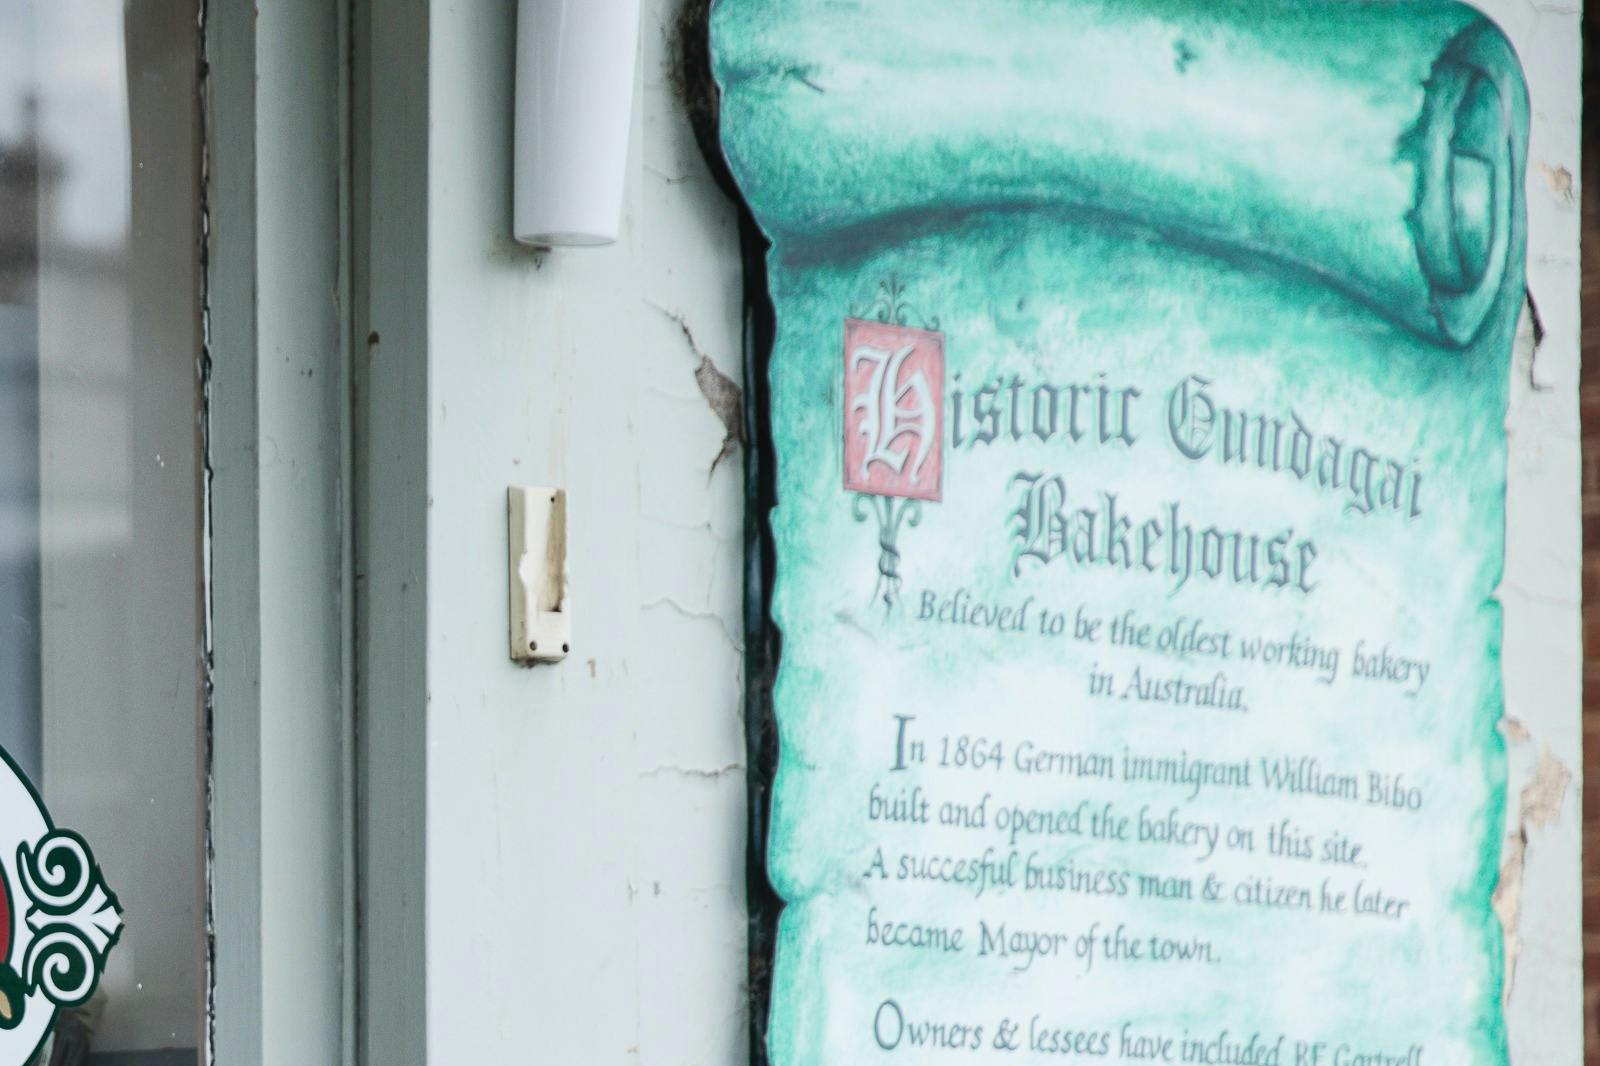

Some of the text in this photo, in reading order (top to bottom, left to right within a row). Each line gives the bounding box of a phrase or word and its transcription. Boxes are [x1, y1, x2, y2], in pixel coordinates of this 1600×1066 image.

[849, 343, 1425, 520] Historic Gundagai
[1008, 469, 1320, 596] Bakehouse
[919, 589, 1430, 696] Believed to be the oldest working bakery
[1089, 664, 1113, 696] in
[889, 714, 1422, 810] In 1864 German immigrant William Bibo
[868, 784, 1368, 869] built and opened the bakery on this site.
[862, 847, 1409, 918] A succesful business man & citizen he later
[866, 909, 1221, 972] became Mayor of the town.
[873, 1000, 983, 1051] Owners
[992, 1021, 1020, 1050] &
[1029, 1016, 1110, 1056] lessees
[1119, 1022, 1174, 1062] have
